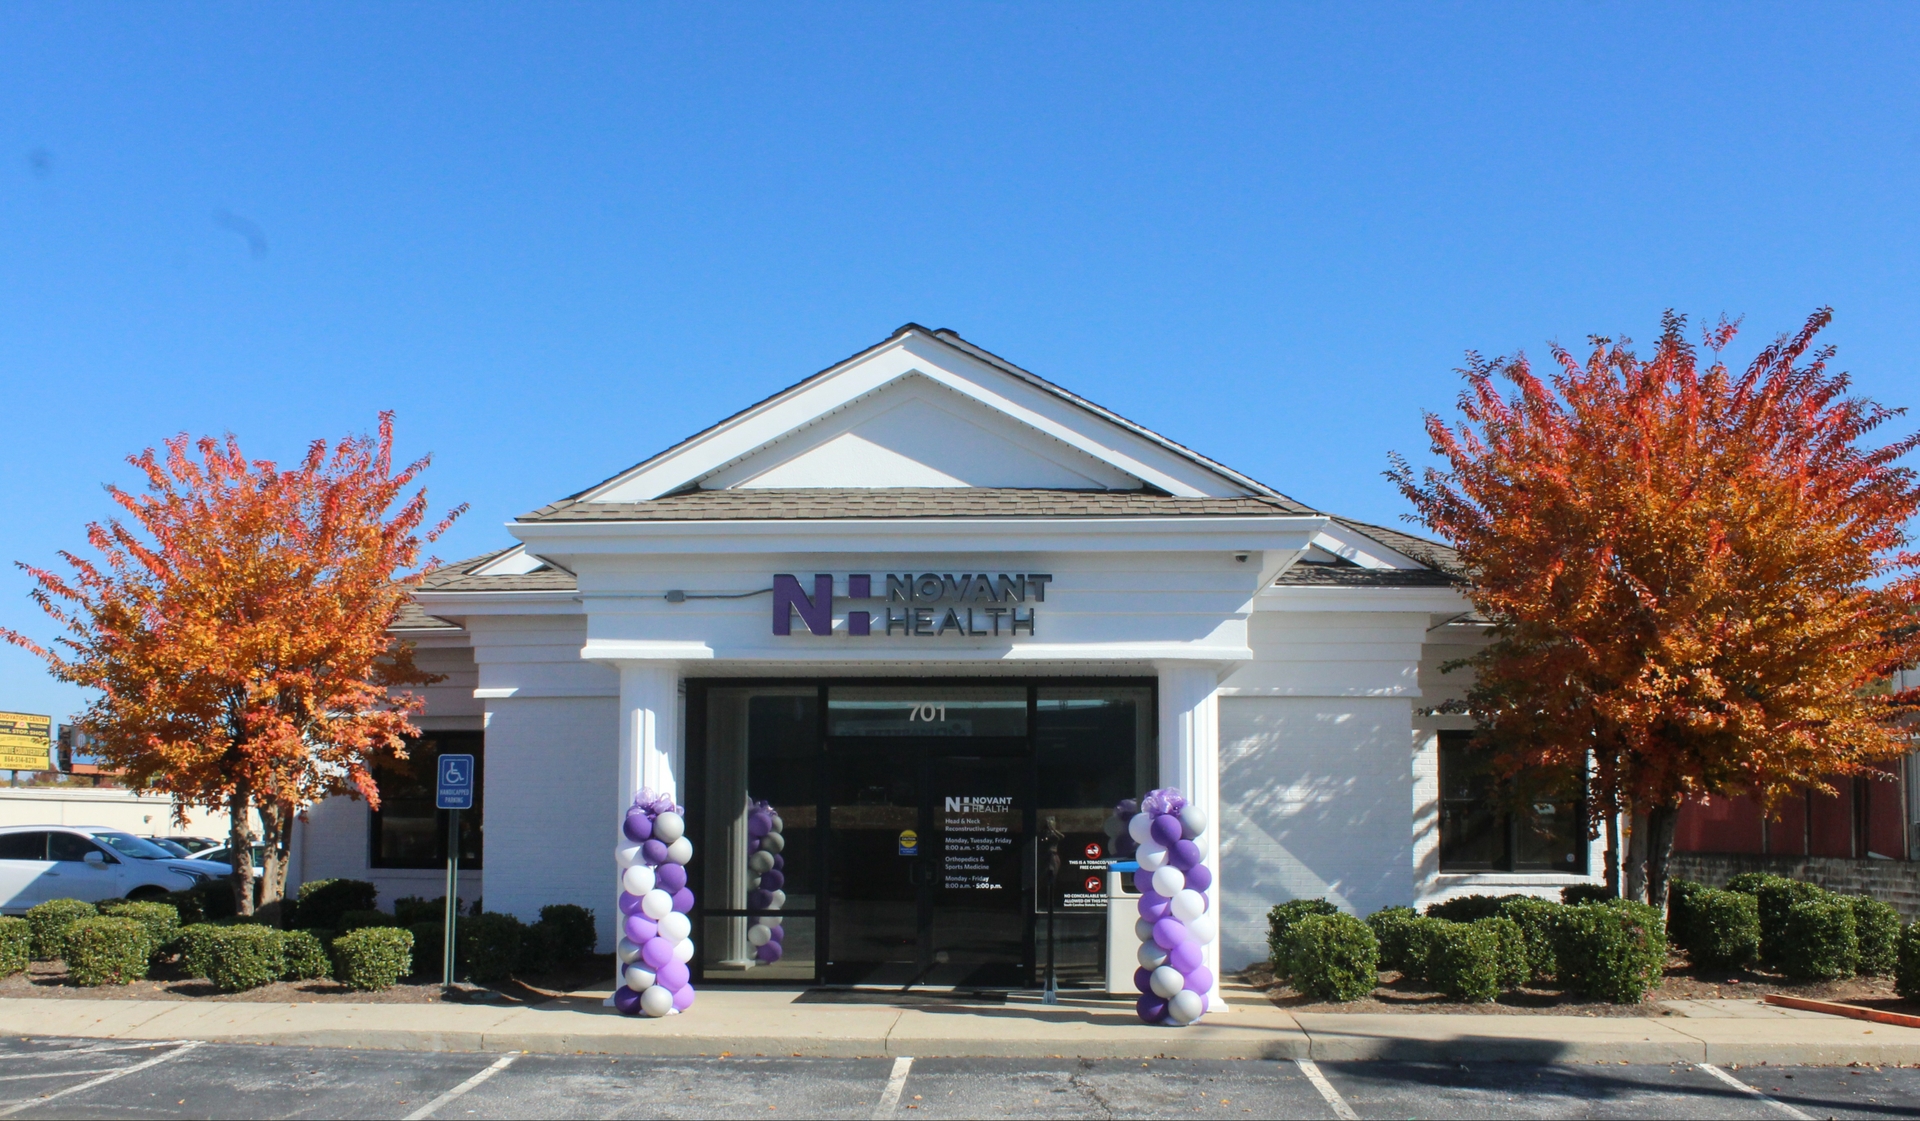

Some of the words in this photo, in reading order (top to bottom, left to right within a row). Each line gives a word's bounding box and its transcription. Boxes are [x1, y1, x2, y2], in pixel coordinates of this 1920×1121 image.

[886, 573, 1053, 602] NOVANT
[886, 608, 1035, 636] HEALTH
[908, 702, 946, 722] 701
[972, 796, 1013, 805] NOVANT
[972, 805, 1009, 813] HEALTH
